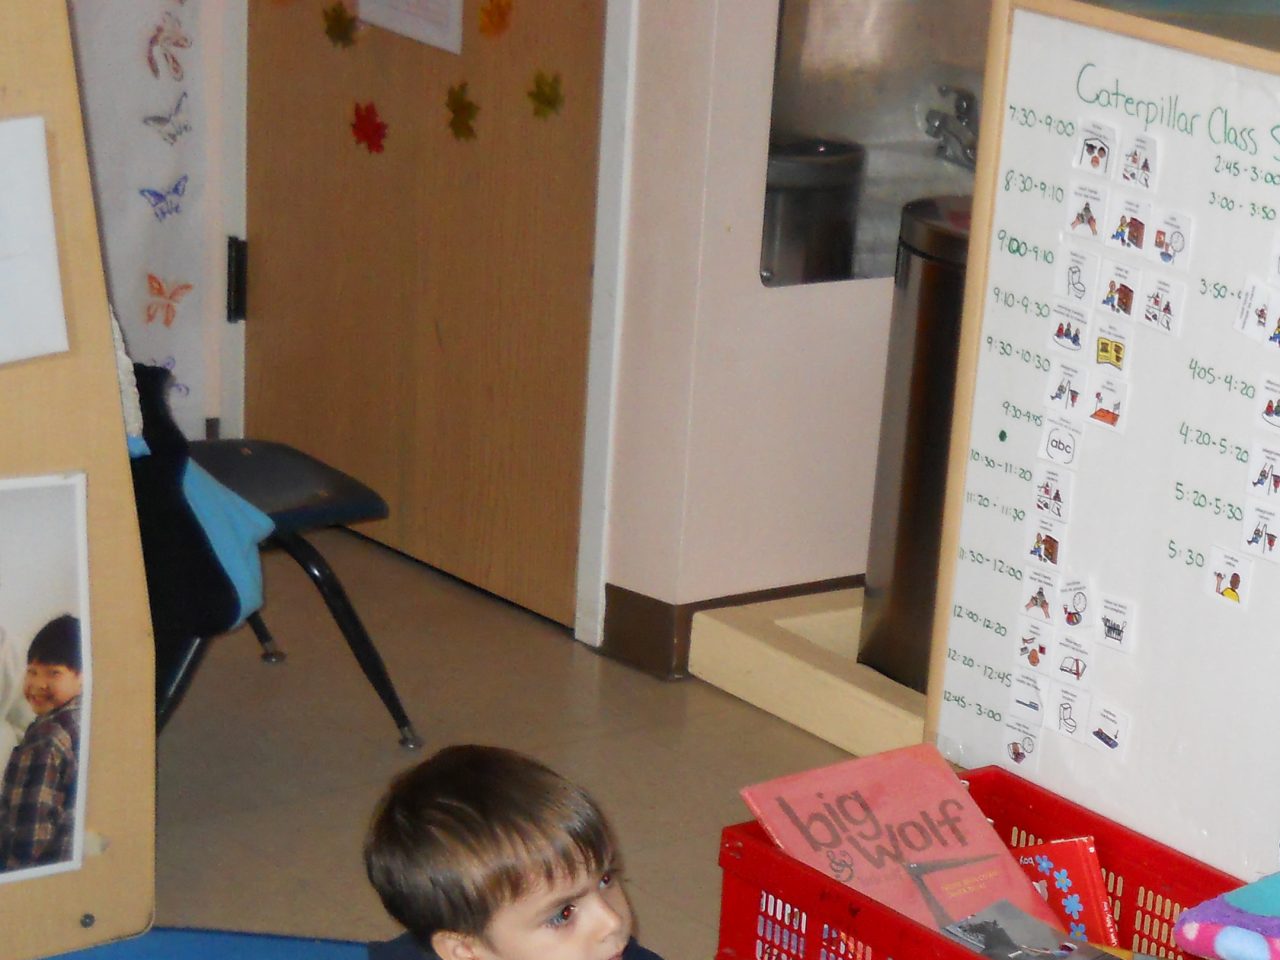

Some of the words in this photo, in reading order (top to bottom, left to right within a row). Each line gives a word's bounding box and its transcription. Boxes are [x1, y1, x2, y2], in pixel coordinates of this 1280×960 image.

[1076, 63, 1200, 136] Caterpillar
[1208, 107, 1258, 155] Class
[1050, 438, 1072, 455] abc
[778, 790, 882, 853] big
[847, 799, 965, 869] wolf
